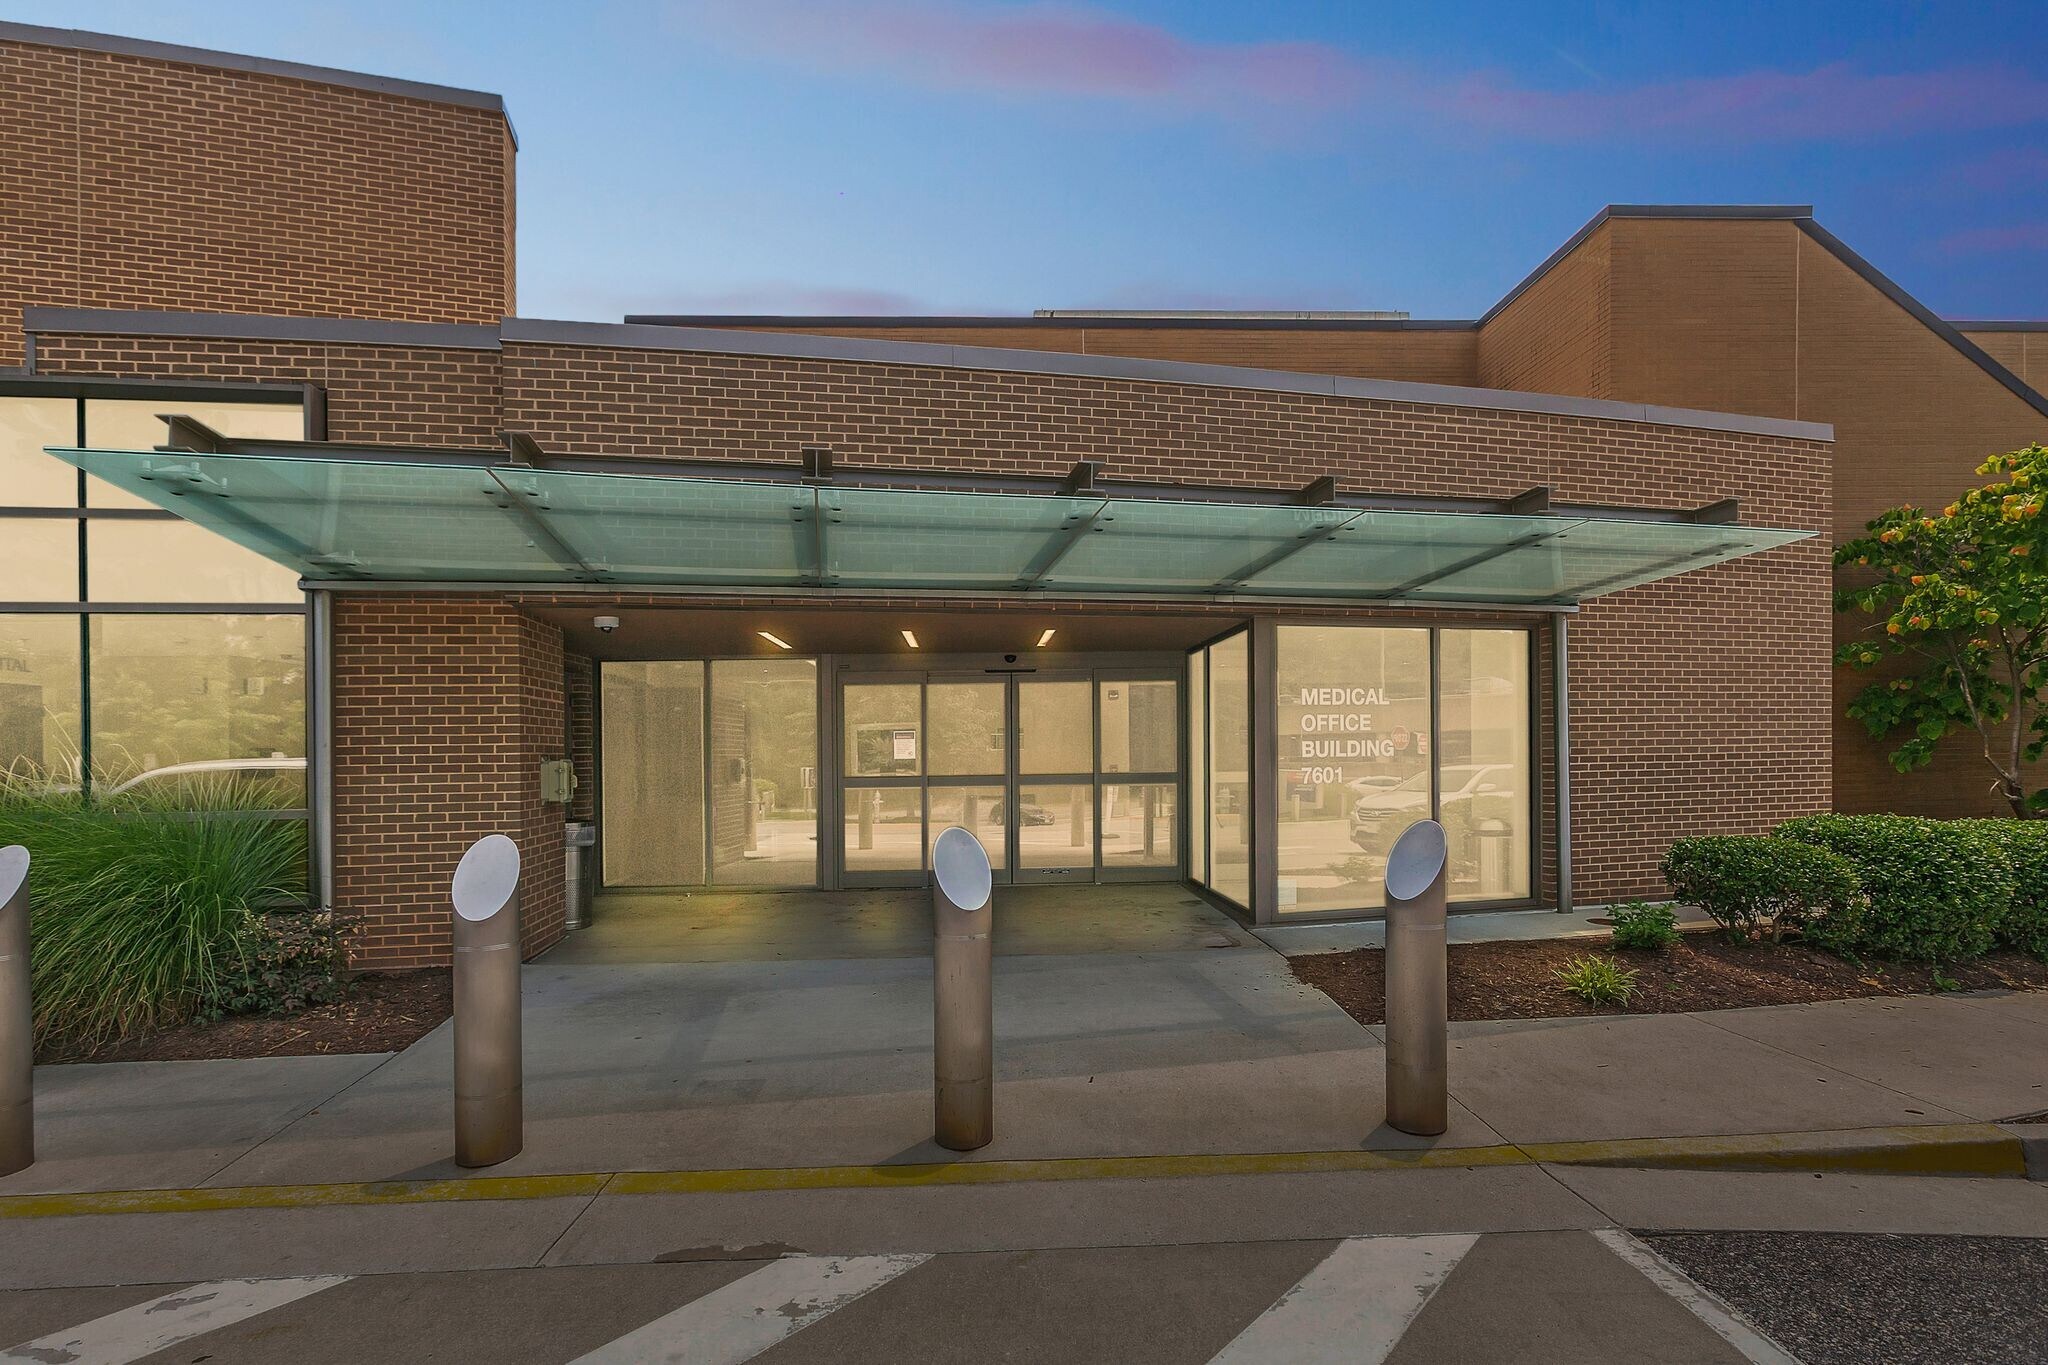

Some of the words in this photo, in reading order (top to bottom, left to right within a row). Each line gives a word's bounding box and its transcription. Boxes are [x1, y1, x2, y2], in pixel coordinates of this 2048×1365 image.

[1301, 687, 1390, 706] MEDICAL
[1301, 713, 1372, 732] OFFICE
[1301, 739, 1395, 758] BUILDING
[1301, 766, 1343, 784] 7601
